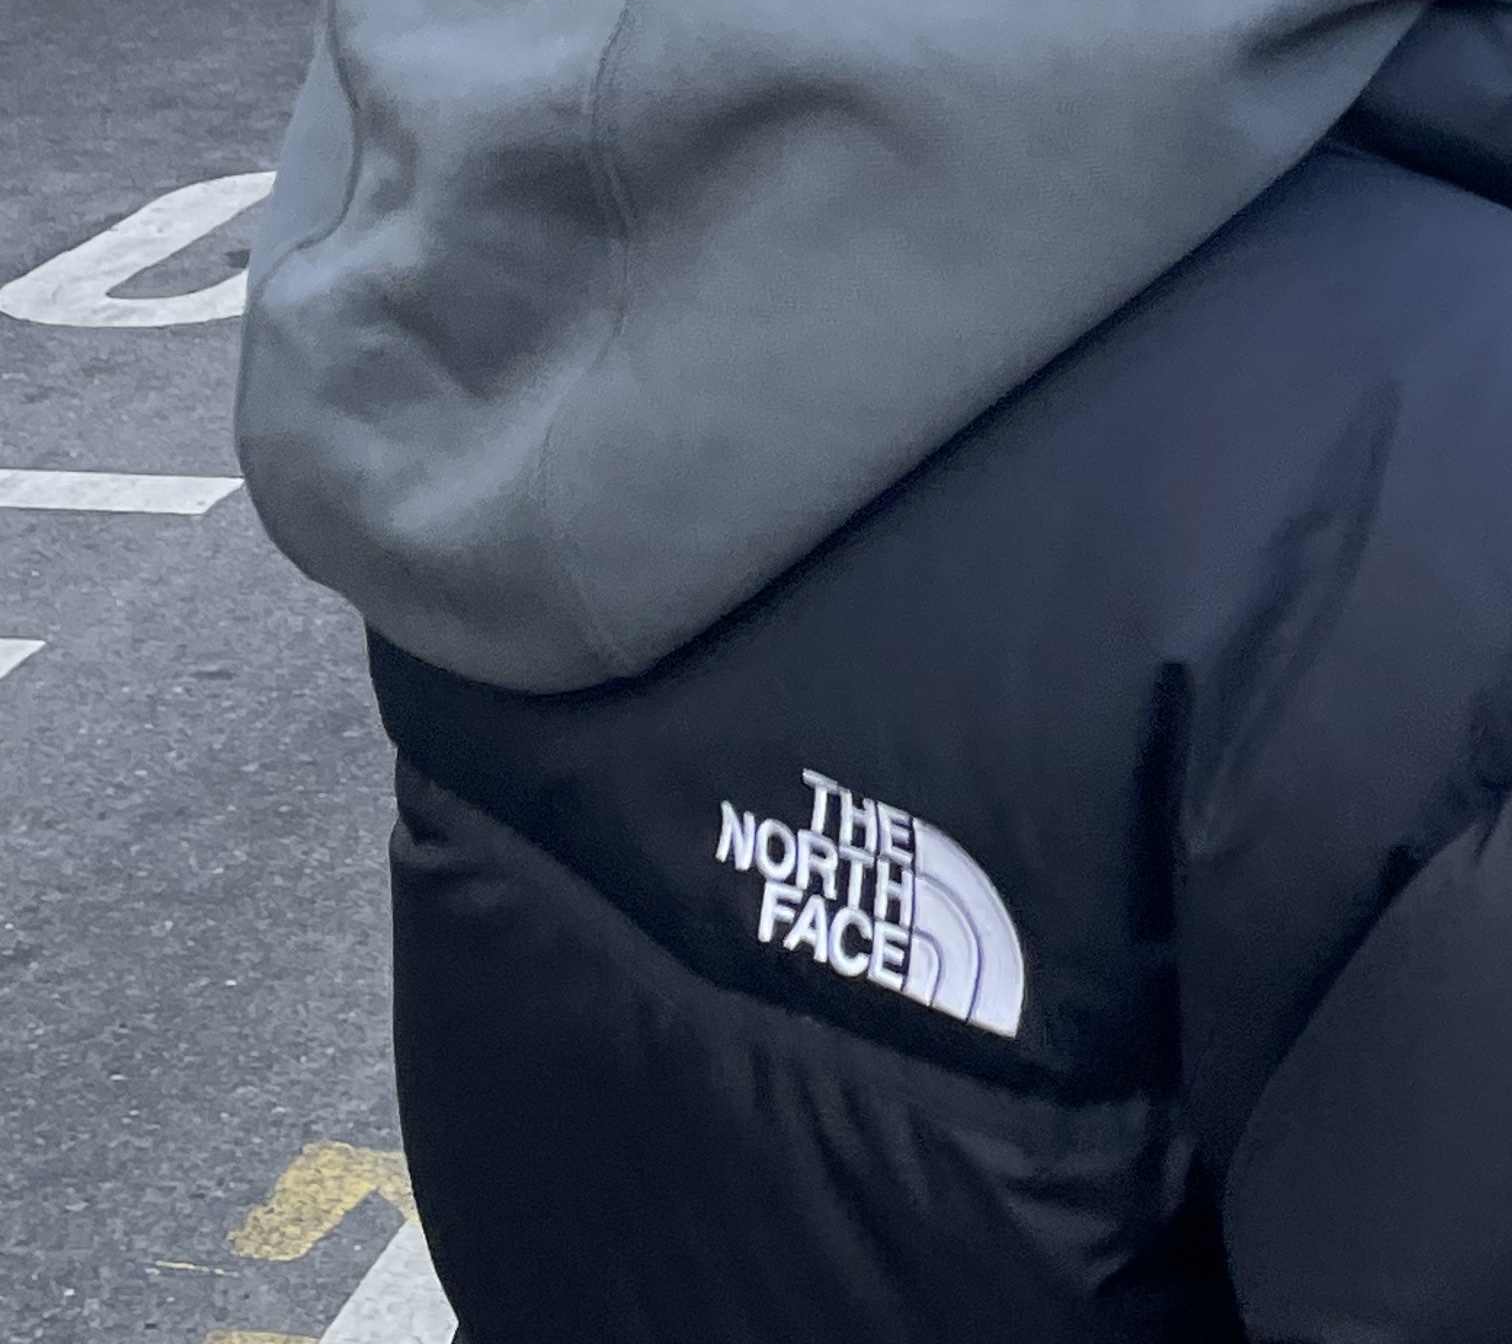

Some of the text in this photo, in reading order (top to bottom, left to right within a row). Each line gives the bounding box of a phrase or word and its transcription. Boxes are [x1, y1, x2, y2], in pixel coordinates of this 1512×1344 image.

[715, 800, 915, 931] NORTH
[802, 768, 915, 864] THE
[757, 878, 911, 993] FACE
